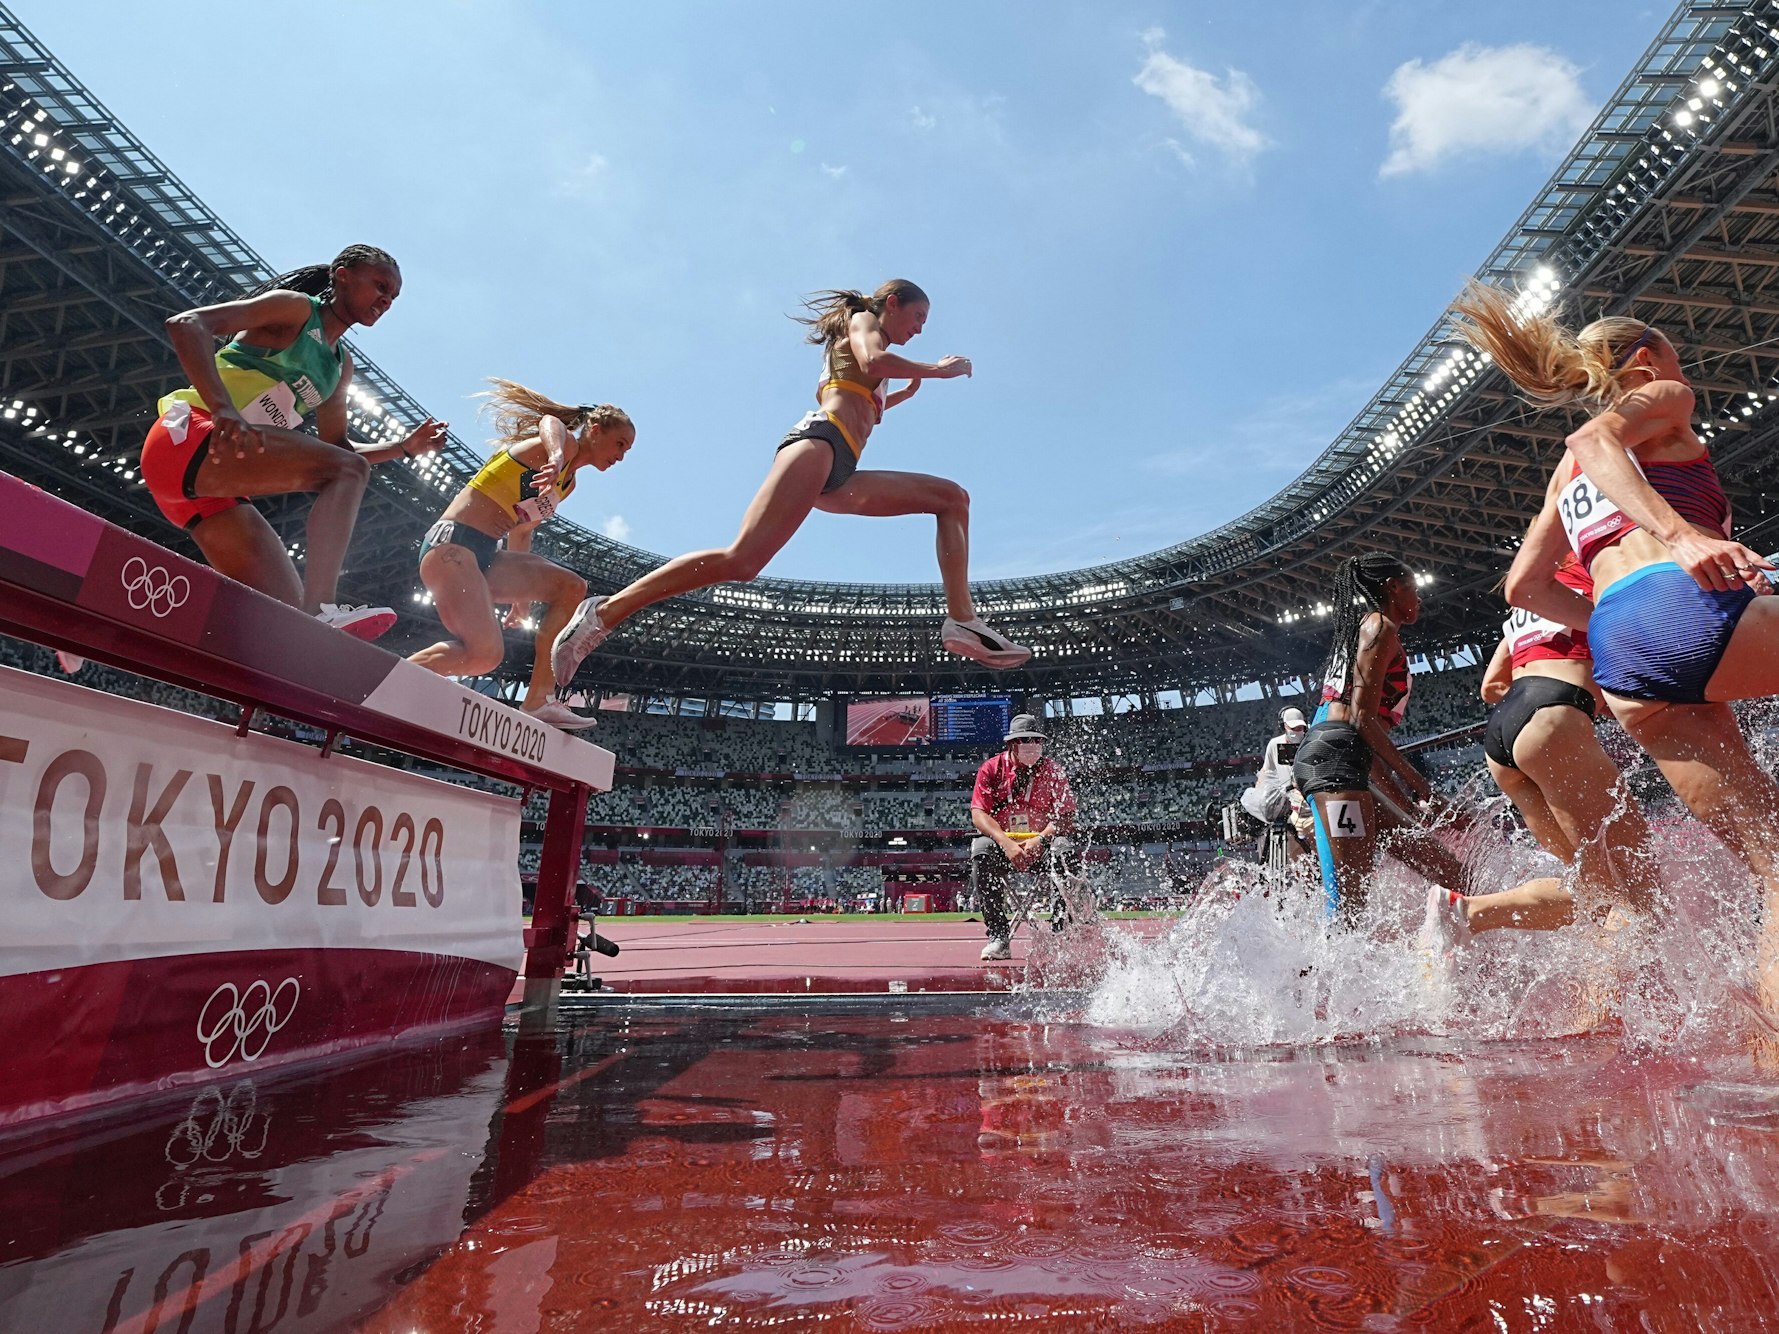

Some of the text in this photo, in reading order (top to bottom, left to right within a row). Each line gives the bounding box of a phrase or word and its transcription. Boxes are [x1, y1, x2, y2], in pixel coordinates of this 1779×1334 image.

[259, 394, 290, 429] WONDE
[459, 697, 546, 763] TOKYO 2020
[0, 735, 444, 908] OKYO 2020
[1137, 821, 1180, 832] TOKYO 2020
[1337, 804, 1356, 833] 4
